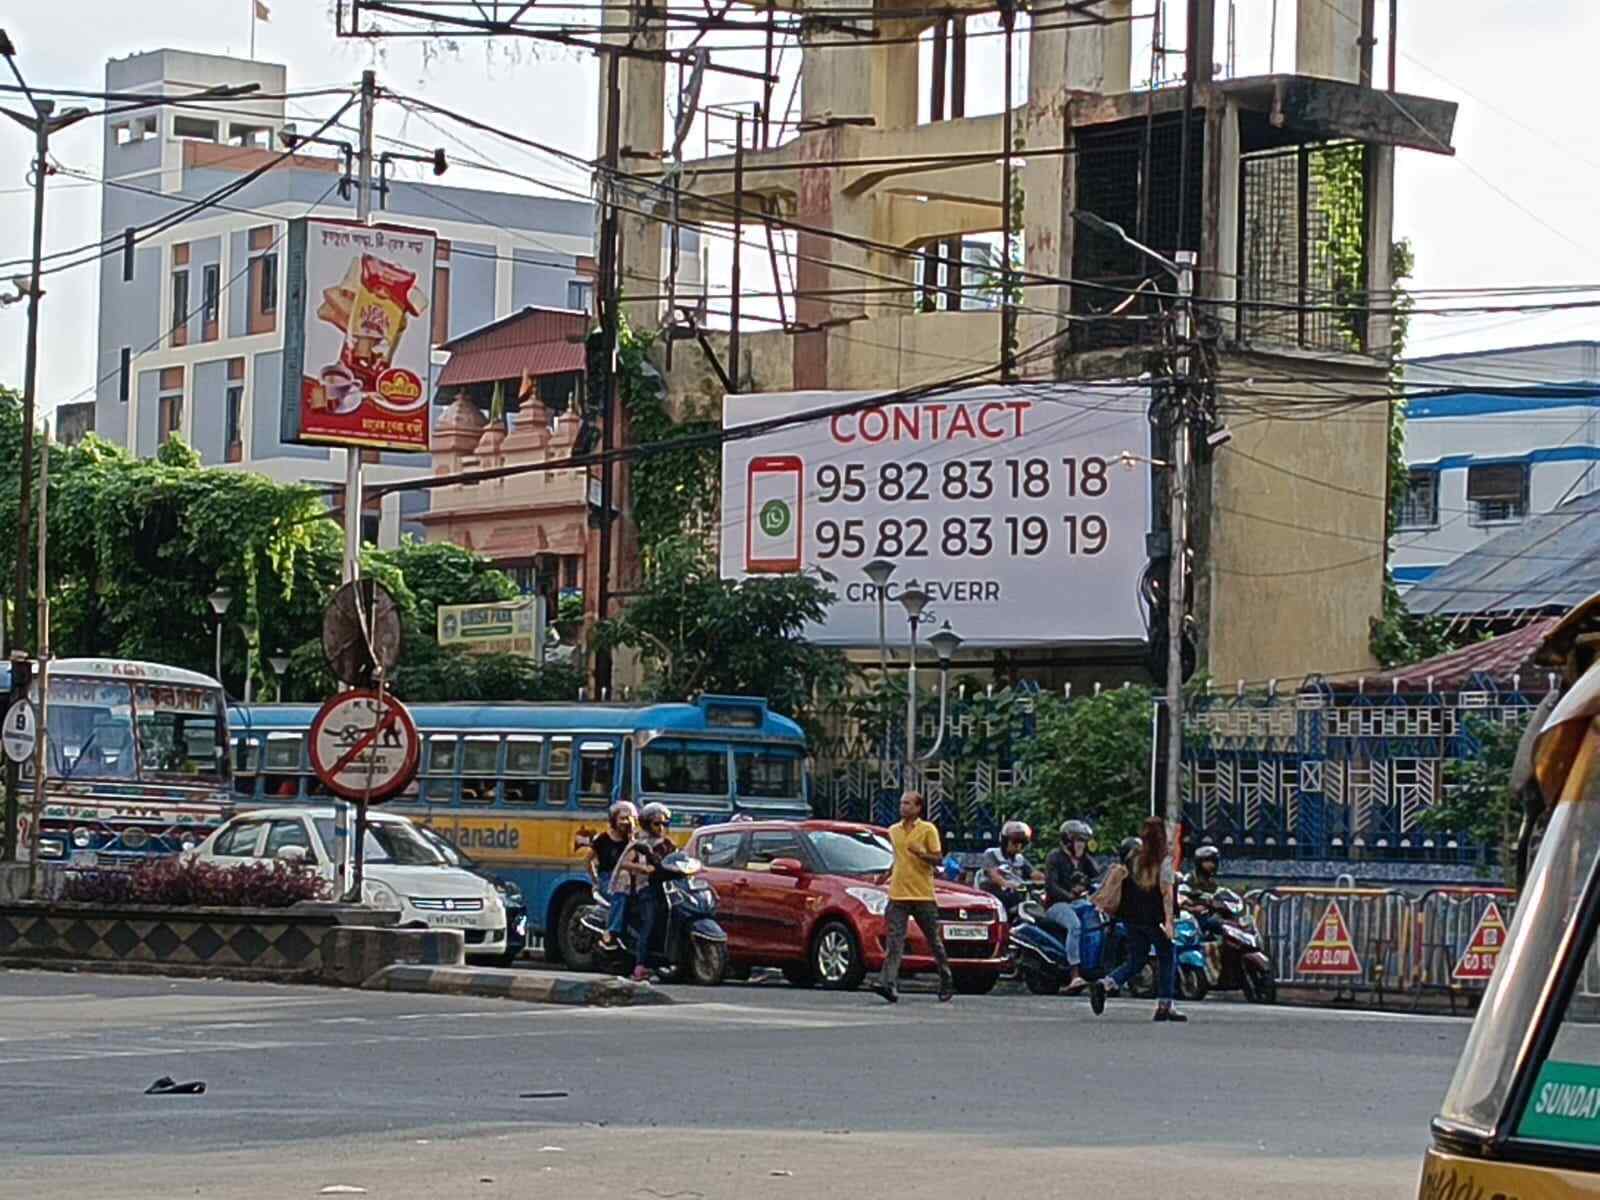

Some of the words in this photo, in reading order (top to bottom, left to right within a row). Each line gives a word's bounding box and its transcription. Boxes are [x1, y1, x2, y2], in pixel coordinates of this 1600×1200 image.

[831, 401, 1031, 443] CONTACT
[816, 464, 866, 503] 95
[878, 461, 930, 501] 82
[942, 460, 993, 500] 83
[1005, 458, 1050, 498] 18
[1062, 456, 1108, 497] 18
[815, 519, 865, 559] 95
[876, 517, 929, 558] 82
[941, 516, 993, 557] 83
[1005, 515, 1049, 556] 19
[1063, 514, 1108, 555] 19
[1305, 949, 1320, 965] GO
[1322, 949, 1350, 965] SLOW
[1464, 953, 1479, 970] GO
